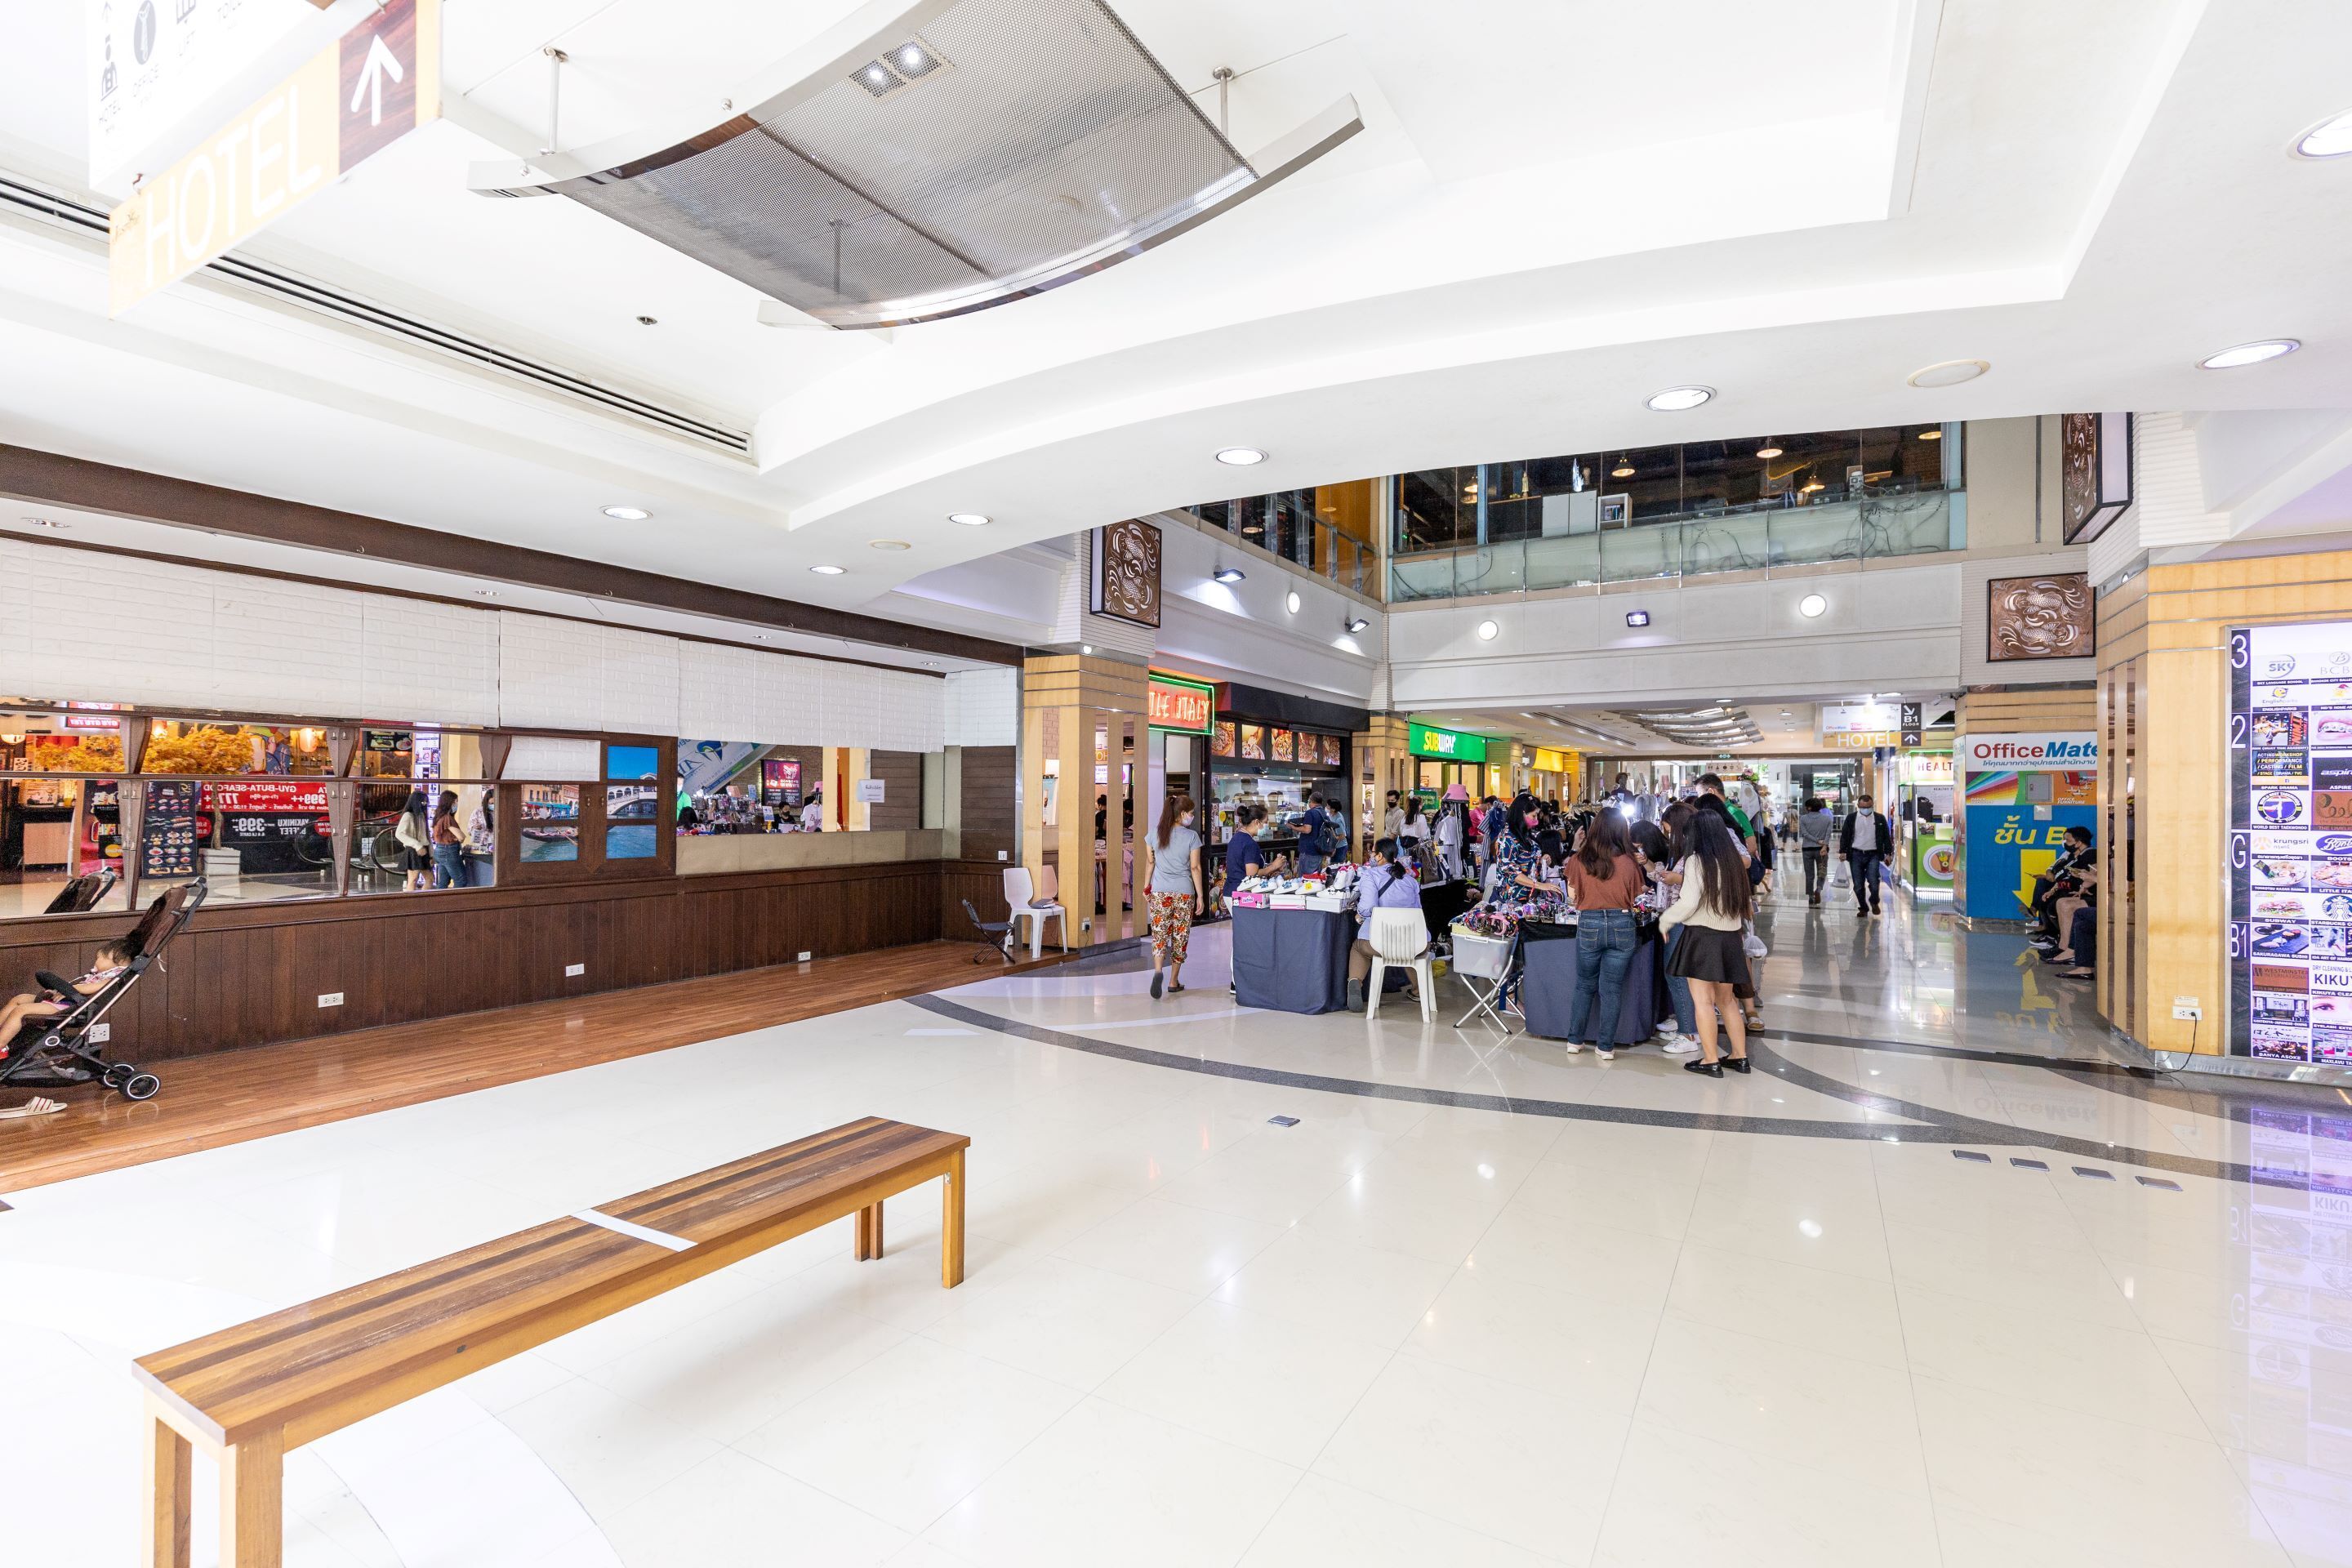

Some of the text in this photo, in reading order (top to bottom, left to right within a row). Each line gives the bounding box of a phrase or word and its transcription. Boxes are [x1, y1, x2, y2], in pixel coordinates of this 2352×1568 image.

[131, 63, 160, 98] OFFICE
[99, 100, 121, 124] HOTEL
[145, 83, 323, 292] HOTEL
[2231, 635, 2247, 668] 3
[2269, 663, 2296, 671] SKY
[1423, 731, 1456, 753] SUBWAY
[1837, 732, 1896, 747] HOTEL
[2232, 715, 2246, 748] 2
[1994, 815, 2037, 844] ชั้น
[2232, 834, 2246, 868] G
[2232, 924, 2247, 958] B1
